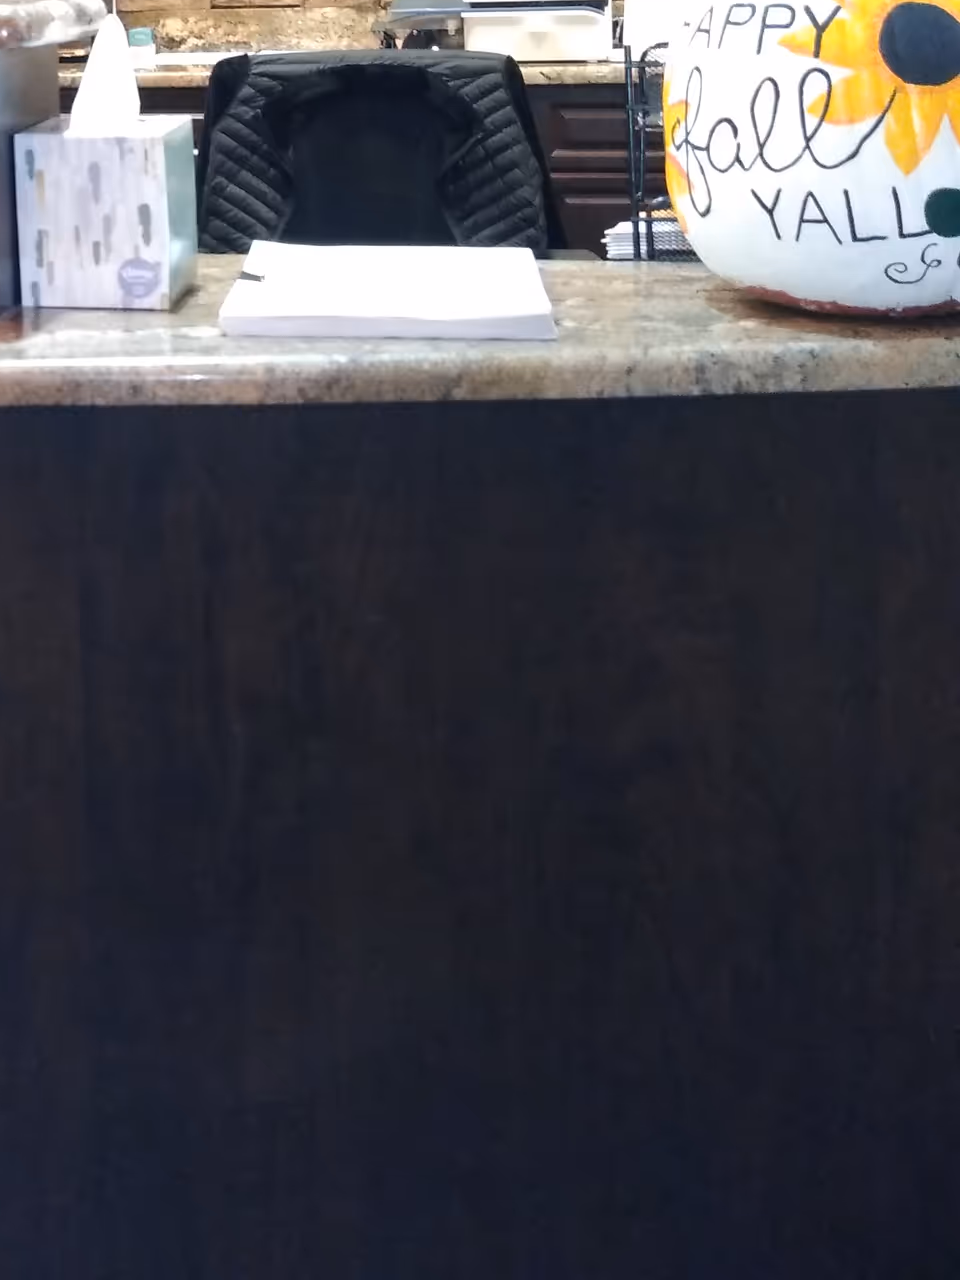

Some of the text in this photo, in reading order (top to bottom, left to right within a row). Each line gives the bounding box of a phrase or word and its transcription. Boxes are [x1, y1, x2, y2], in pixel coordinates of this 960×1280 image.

[683, 3, 842, 58] APPY
[671, 66, 897, 217] fall
[751, 186, 935, 245] YALL
